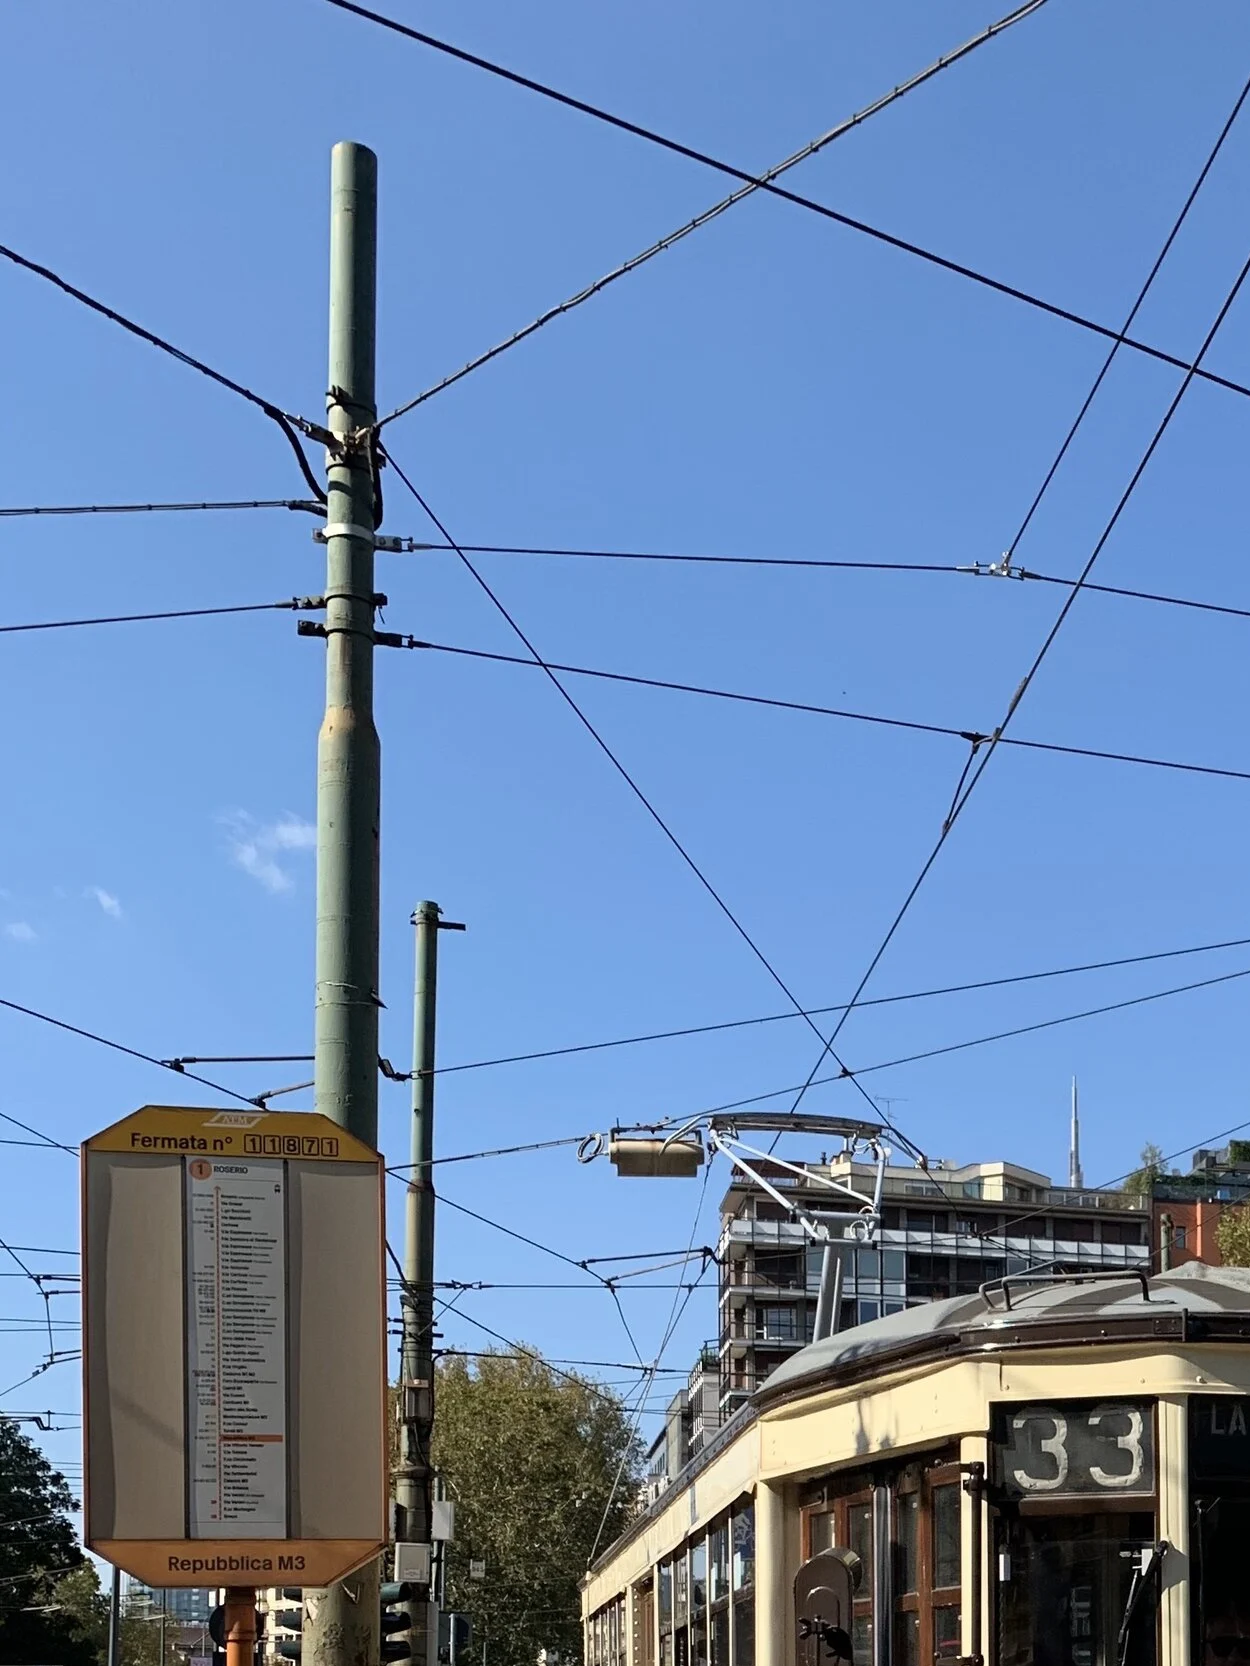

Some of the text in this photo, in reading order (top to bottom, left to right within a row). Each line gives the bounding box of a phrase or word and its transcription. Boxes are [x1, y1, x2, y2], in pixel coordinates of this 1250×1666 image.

[131, 1133, 336, 1155] Fermata n° 11871
[213, 1165, 248, 1174] ROSERIO
[1012, 1404, 1144, 1490] 33
[168, 1556, 305, 1573] Repubblica M3
